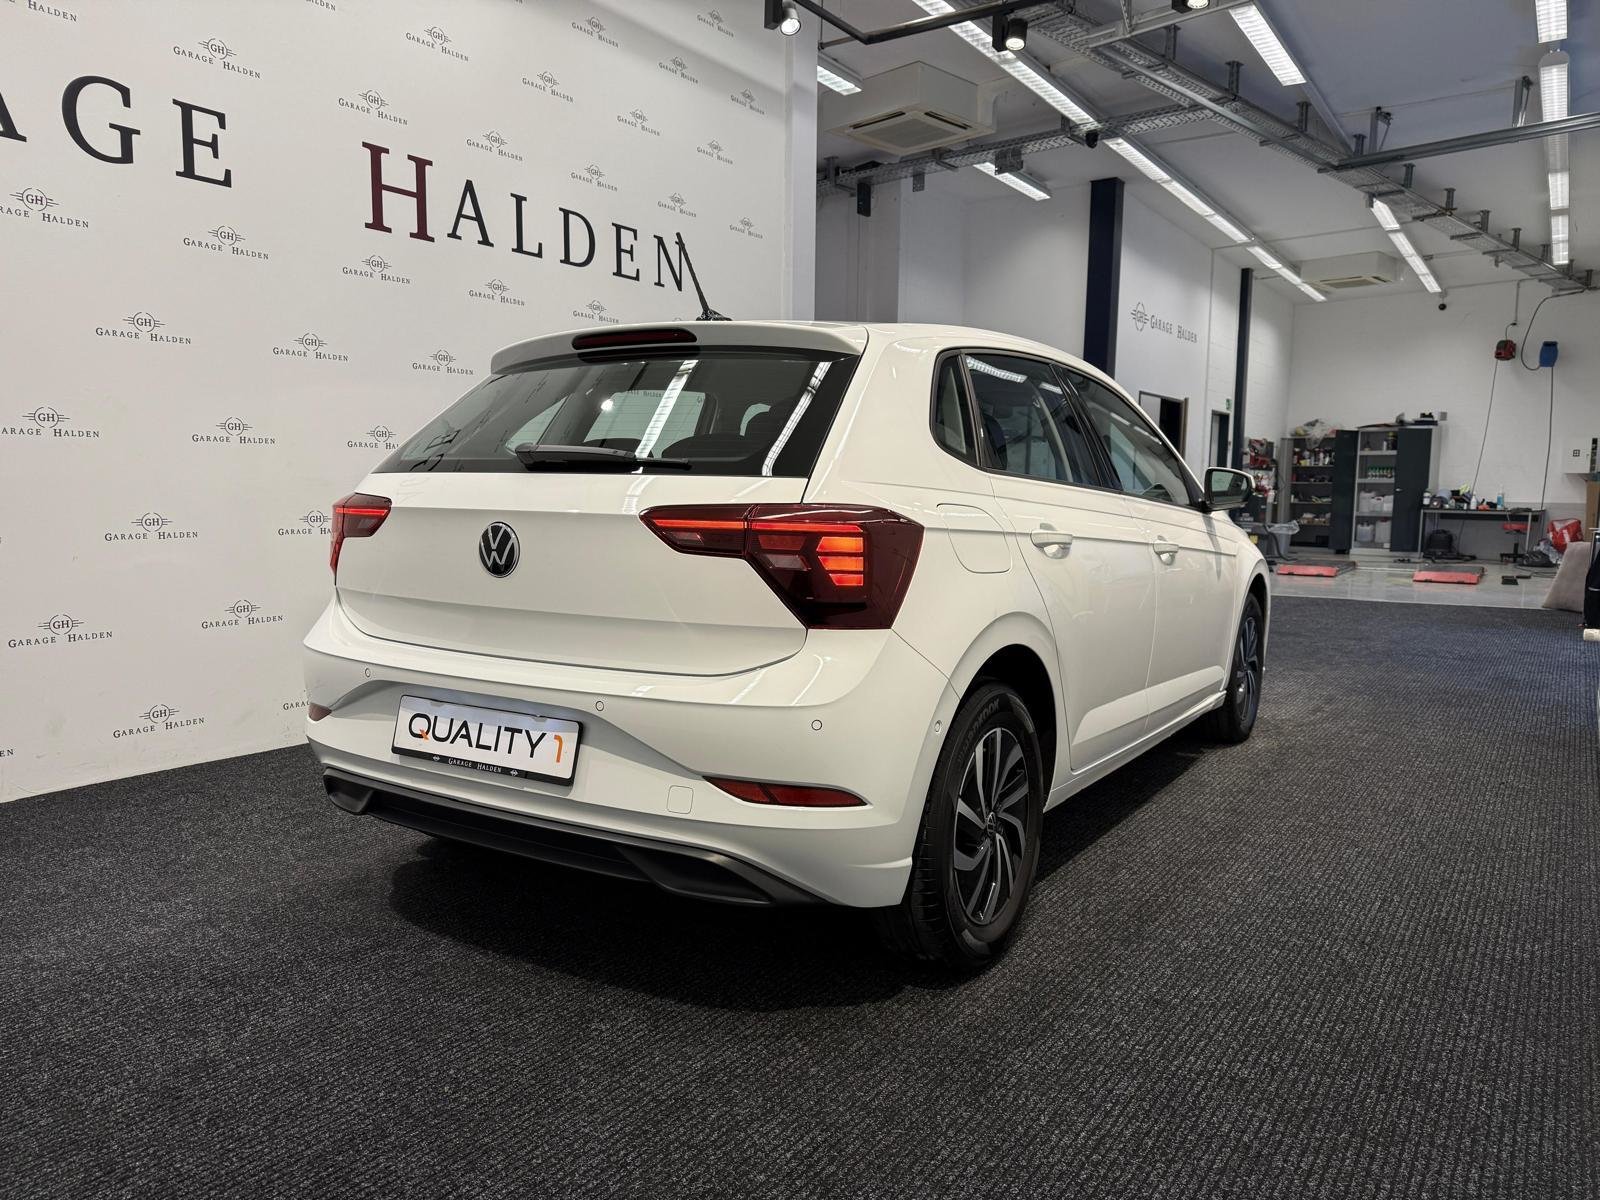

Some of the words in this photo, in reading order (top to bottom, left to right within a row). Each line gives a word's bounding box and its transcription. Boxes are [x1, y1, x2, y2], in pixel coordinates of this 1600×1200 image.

[28, 0, 77, 21] HALDEN
[305, 0, 336, 11] LDEN
[591, 19, 600, 29] GH
[433, 30, 443, 41] GH
[572, 22, 594, 37] GARAGE
[599, 34, 619, 48] HALDEN
[210, 43, 225, 55] GH
[406, 32, 436, 49] GARAGE
[441, 46, 469, 62] HALDEN
[173, 46, 214, 65] GARAGE
[223, 61, 261, 78] HALDEN
[544, 75, 553, 85] GH
[522, 77, 546, 92] GARAGE
[551, 88, 573, 103] HALDEN
[368, 94, 380, 105] GH
[338, 97, 371, 115] GARAGE
[377, 110, 408, 126] HALDEN
[635, 112, 644, 122] GH
[617, 115, 637, 128] GARAGE
[641, 124, 660, 137] HALDEN
[491, 135, 500, 144] GH
[466, 138, 494, 152] GARAGE
[498, 149, 523, 162] HALDEN
[590, 168, 599, 177] GH
[571, 171, 593, 184] GARAGE
[597, 180, 618, 192] HALDEN
[26, 194, 43, 205] GH
[42, 213, 88, 227] HALDEN
[362, 141, 683, 292] HALDEN
[219, 230, 234, 241] GH
[183, 237, 223, 252] GARAGE
[232, 247, 269, 260] HALDEN
[371, 259, 383, 269] GH
[342, 266, 374, 279] GARAGE
[381, 273, 411, 285] HALDEN
[492, 283, 503, 292] GH
[469, 289, 496, 300] GARAGE
[500, 295, 525, 306] HALDEN
[136, 317, 152, 328] GH
[1151, 315, 1173, 335] GARAGE
[1177, 325, 1198, 343] HALDEN
[95, 327, 140, 340] GARAGE
[150, 332, 192, 345] HALDEN
[304, 338, 317, 347] GH
[273, 347, 307, 358] GARAGE
[315, 351, 348, 362] HALDEN
[438, 354, 448, 362] GH
[412, 362, 440, 373] GARAGE
[446, 365, 474, 376] HALDEN
[38, 412, 55, 422] GH
[227, 422, 241, 431] GH
[2, 427, 41, 436] ARAGE
[53, 428, 100, 438] HALDEN
[375, 430, 387, 438] GH
[192, 434, 231, 444] GARAGE
[239, 436, 276, 445] HALDEN
[347, 440, 379, 448] GARAGE
[144, 518, 160, 527] GH
[309, 515, 321, 523] GH
[104, 532, 148, 542] GARAGE
[158, 531, 198, 540] HALDEN
[278, 528, 313, 536] GARAGE
[236, 604, 250, 614] GH
[52, 619, 70, 630] GH
[201, 619, 239, 629] GARAGE
[248, 615, 283, 624] HALDEN
[8, 636, 57, 648] GARAGE
[68, 631, 113, 642] HALDEN
[152, 708, 167, 719] GH
[113, 725, 155, 738] GARAGE
[165, 717, 205, 729] HALDEN
[409, 713, 547, 758] QUALITY
[448, 758, 472, 768] GARAGE
[477, 763, 501, 773] HALDEN
